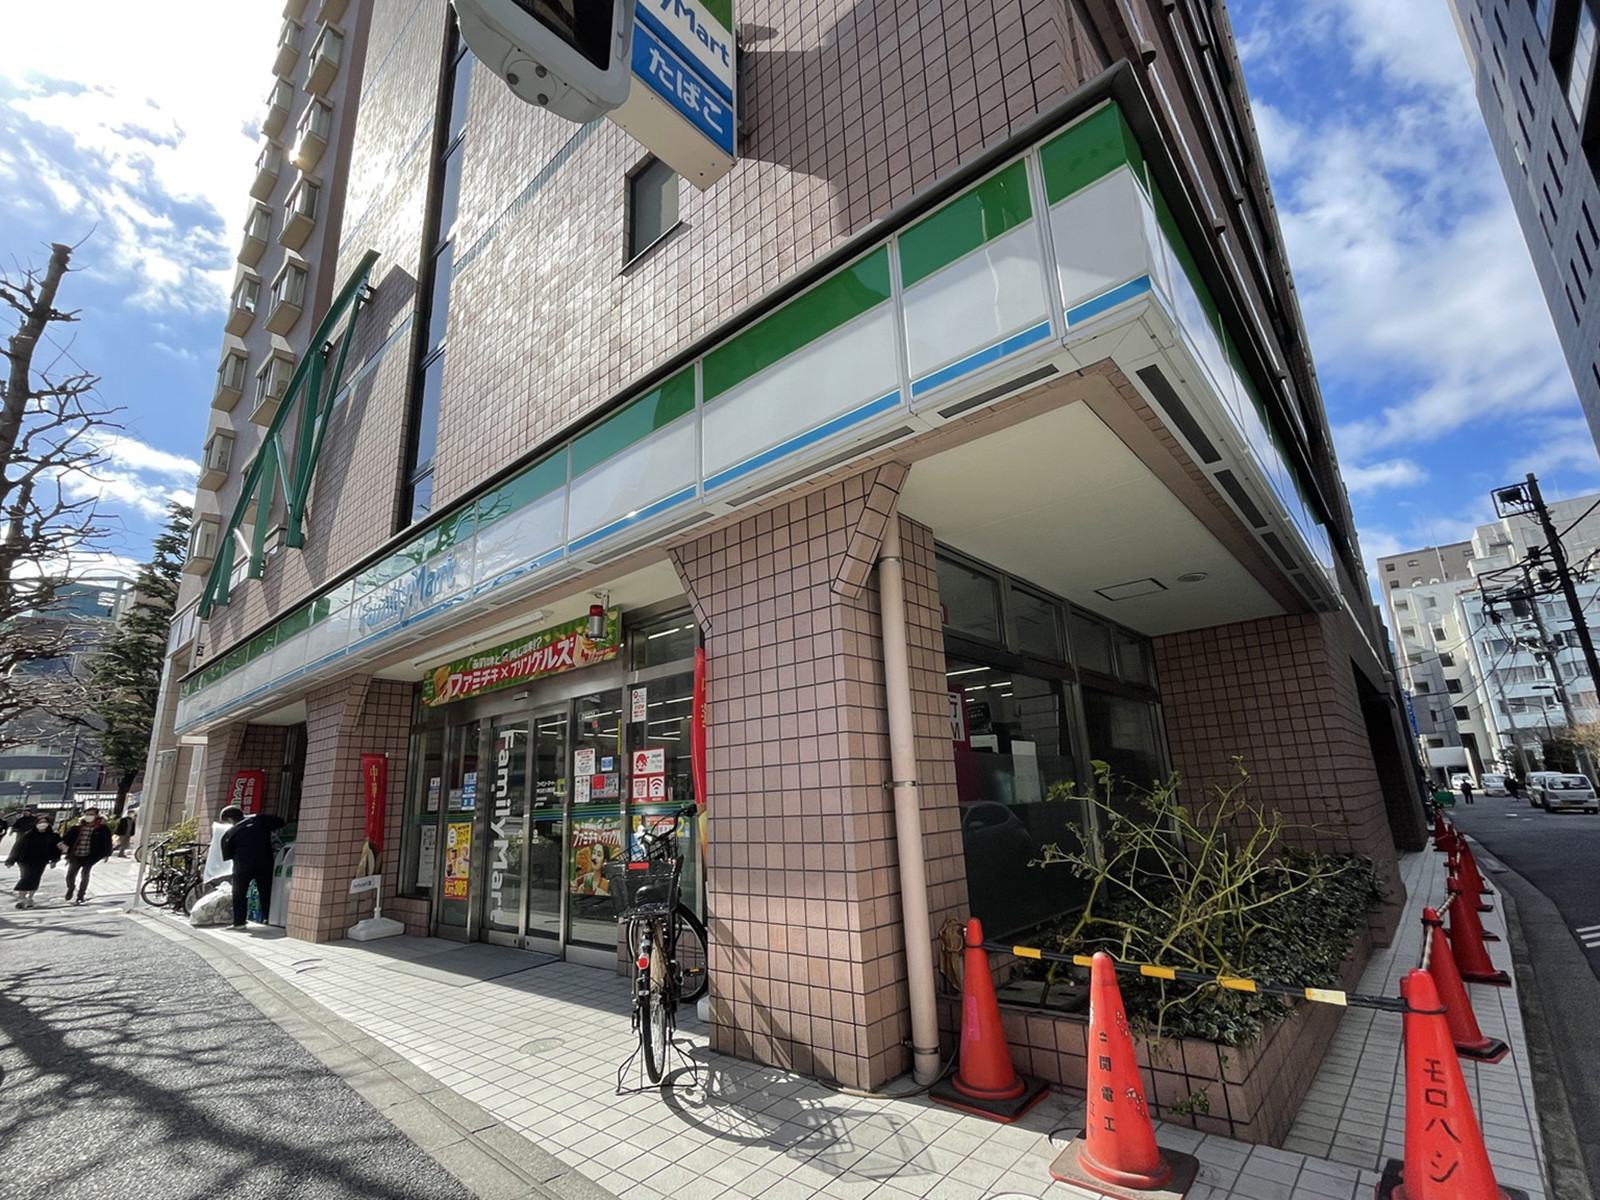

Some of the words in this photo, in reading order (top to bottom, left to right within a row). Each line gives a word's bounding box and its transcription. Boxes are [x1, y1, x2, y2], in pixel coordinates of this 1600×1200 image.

[660, 0, 730, 68] Mart
[648, 47, 724, 134] たばこ
[490, 729, 515, 923] FamilyMart
